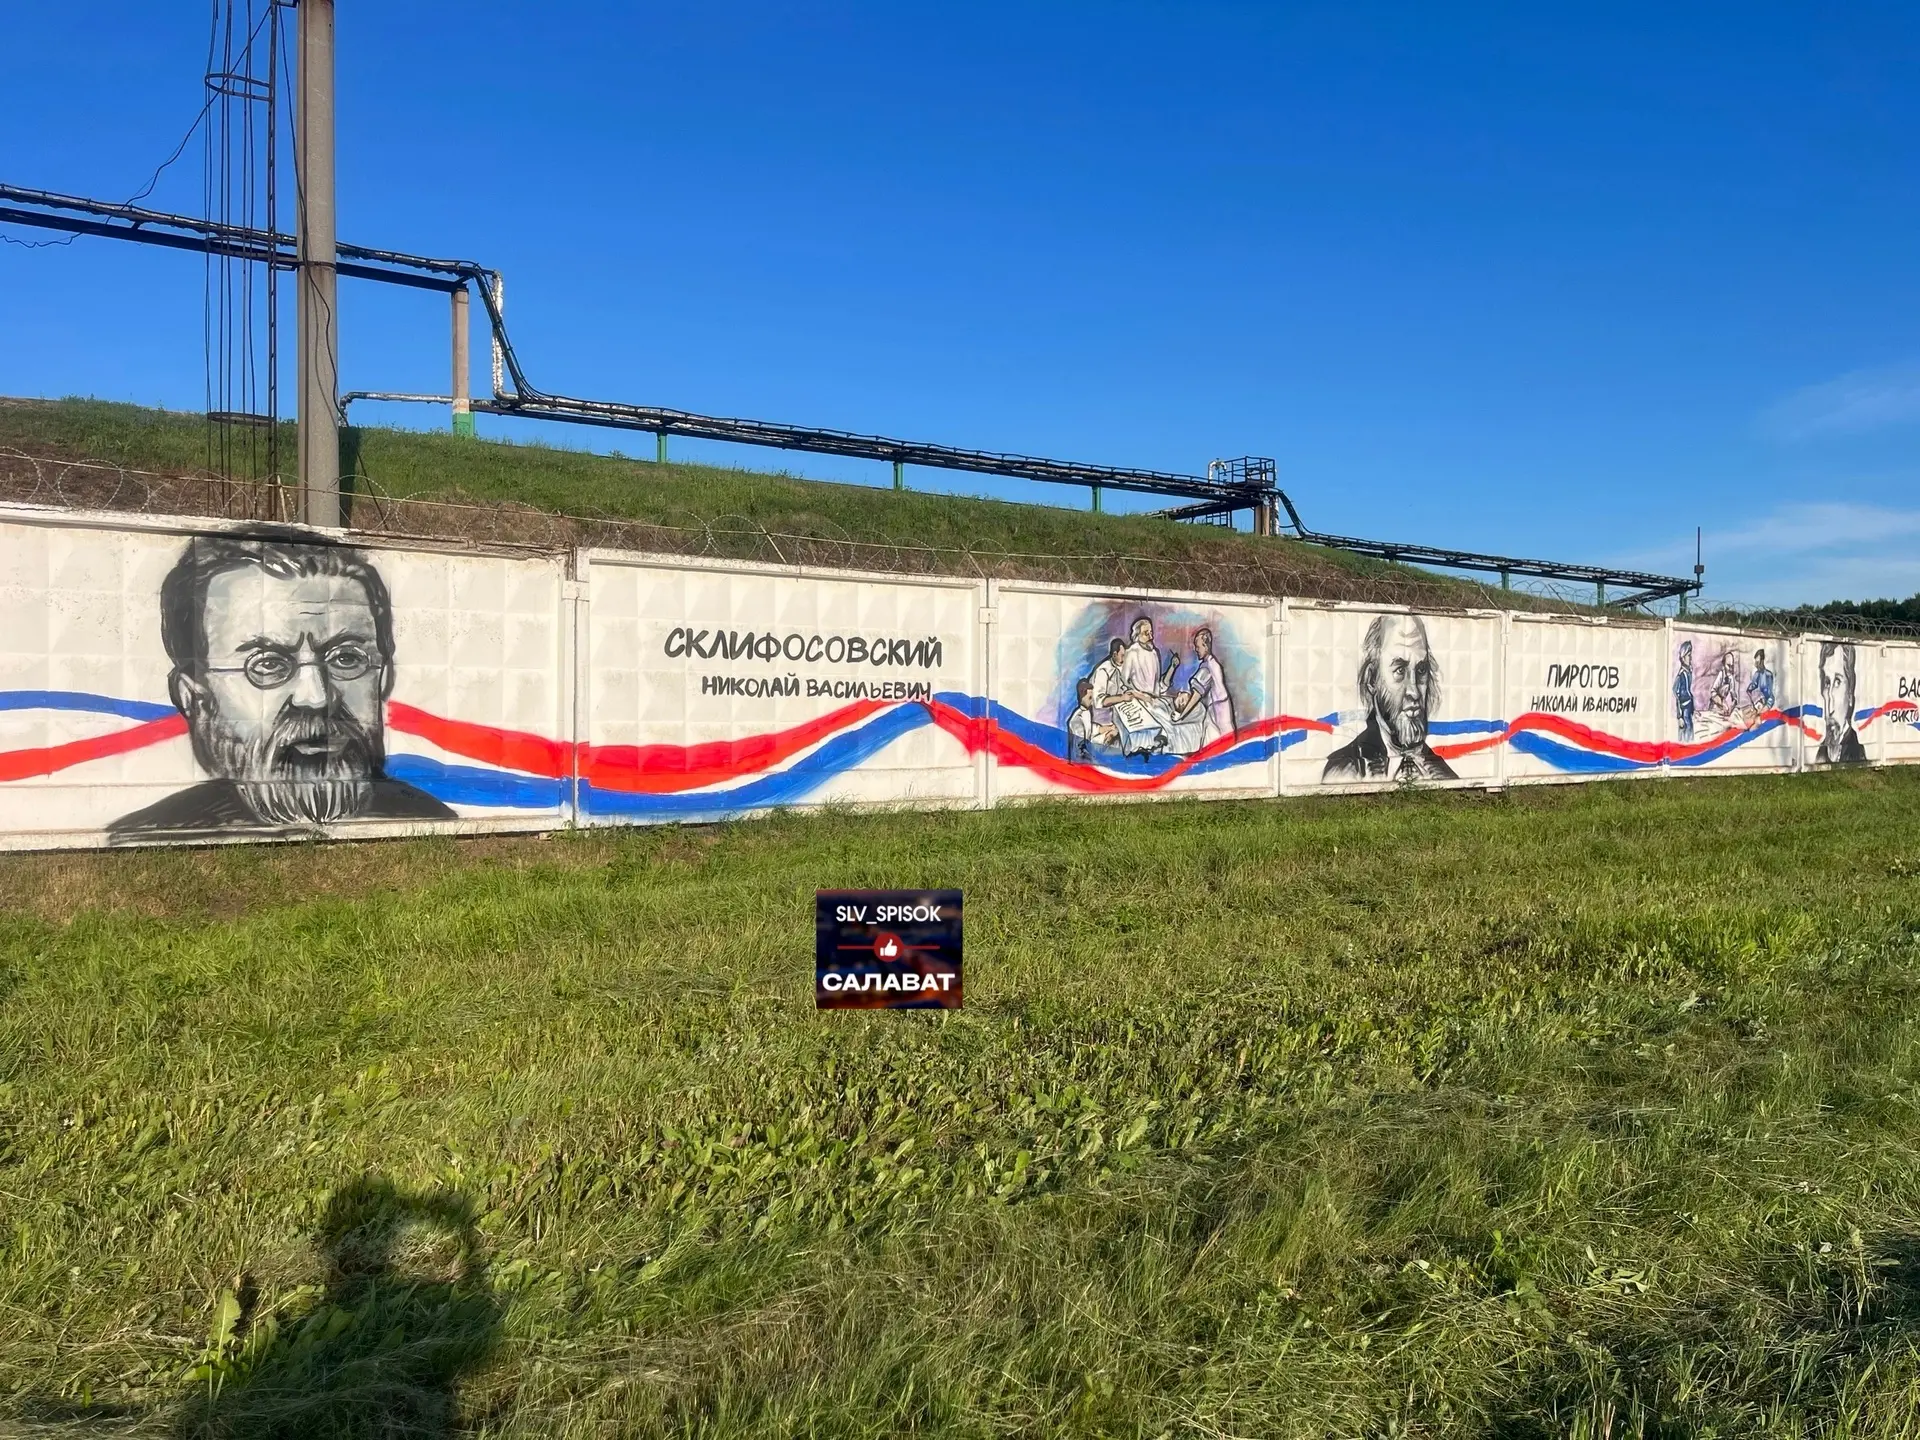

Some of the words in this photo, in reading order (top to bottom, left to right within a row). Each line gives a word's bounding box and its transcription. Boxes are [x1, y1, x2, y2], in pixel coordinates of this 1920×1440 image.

[664, 627, 943, 669] СКЛИФОСОВСКИЙ
[701, 673, 800, 698] НИКОЛАЙ
[806, 678, 932, 702] ВАСИЛЬЕВИЧ
[1546, 663, 1620, 689] ПИРОГОВ
[1530, 693, 1578, 713] НИКОЛАЙ
[1582, 695, 1638, 714] ИВАНОВИЧ
